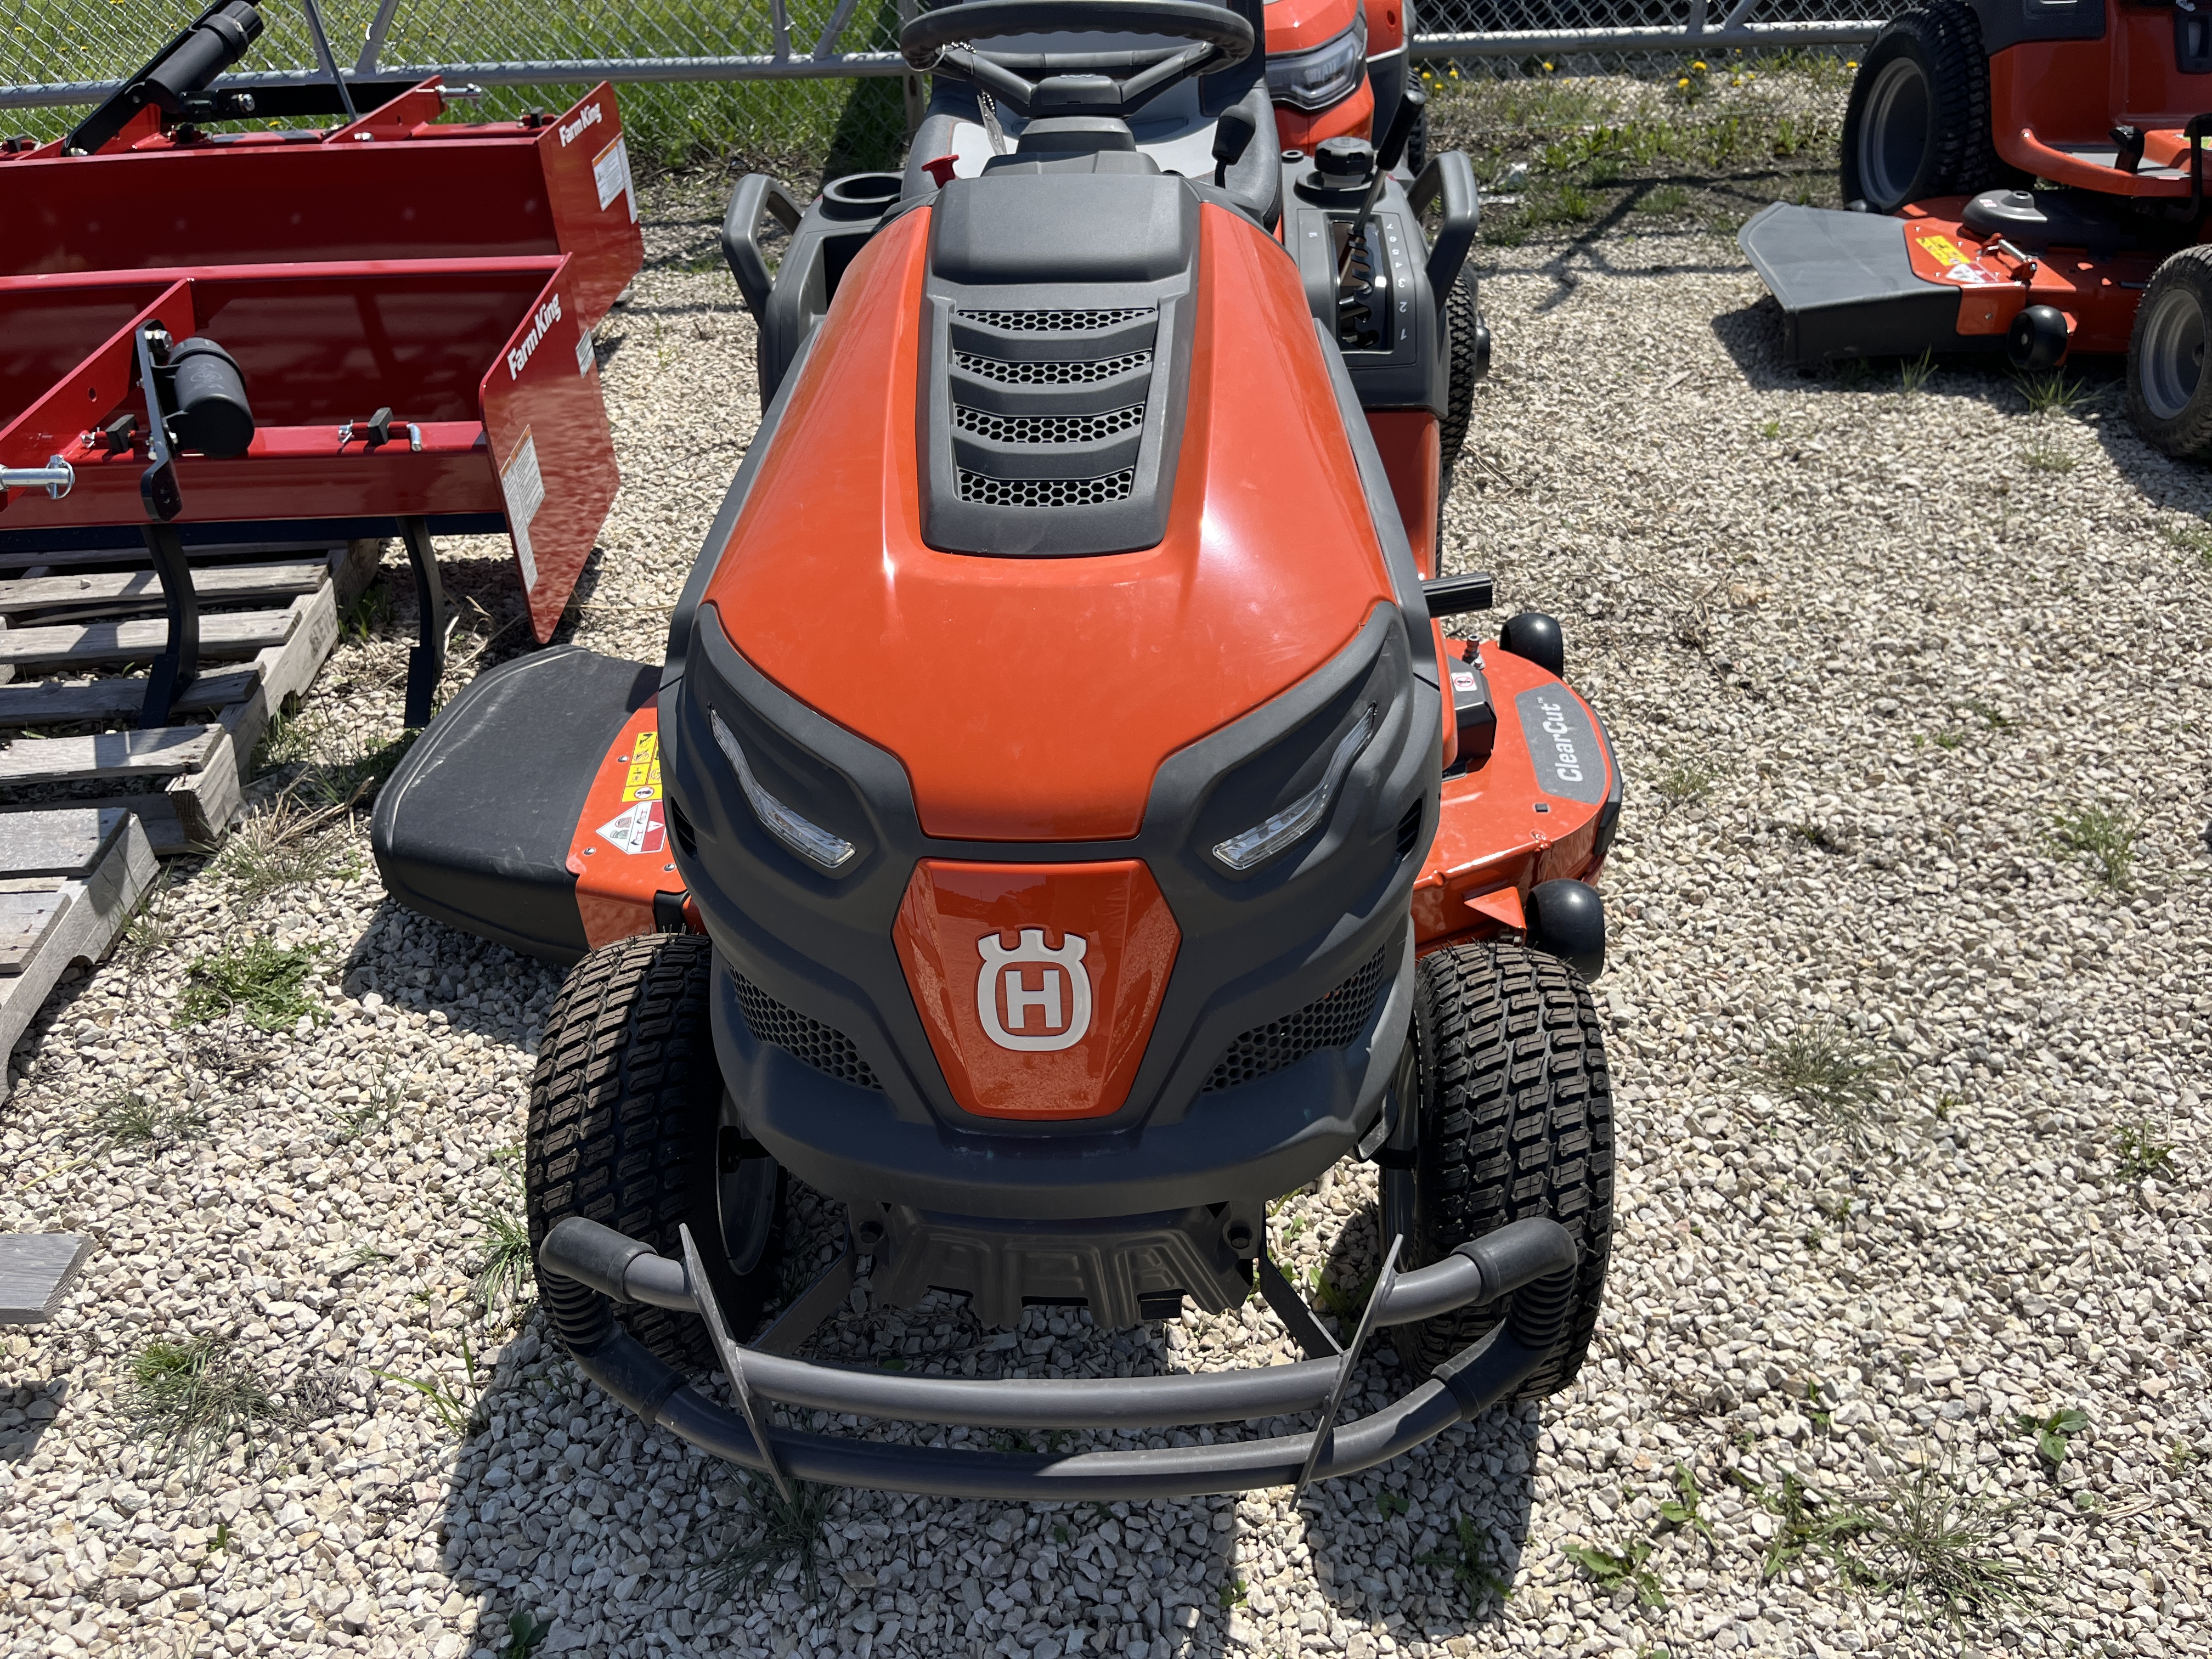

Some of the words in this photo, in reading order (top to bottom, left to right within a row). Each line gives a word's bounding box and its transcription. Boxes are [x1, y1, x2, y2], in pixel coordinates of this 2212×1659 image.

[558, 119, 584, 148] Farm
[580, 102, 602, 129] King
[1398, 278, 1406, 288] 3
[1399, 302, 1407, 313] 2
[507, 328, 539, 381] Farm
[534, 293, 562, 340] King
[1400, 329, 1407, 341] 1
[1005, 969, 1062, 1029] H
